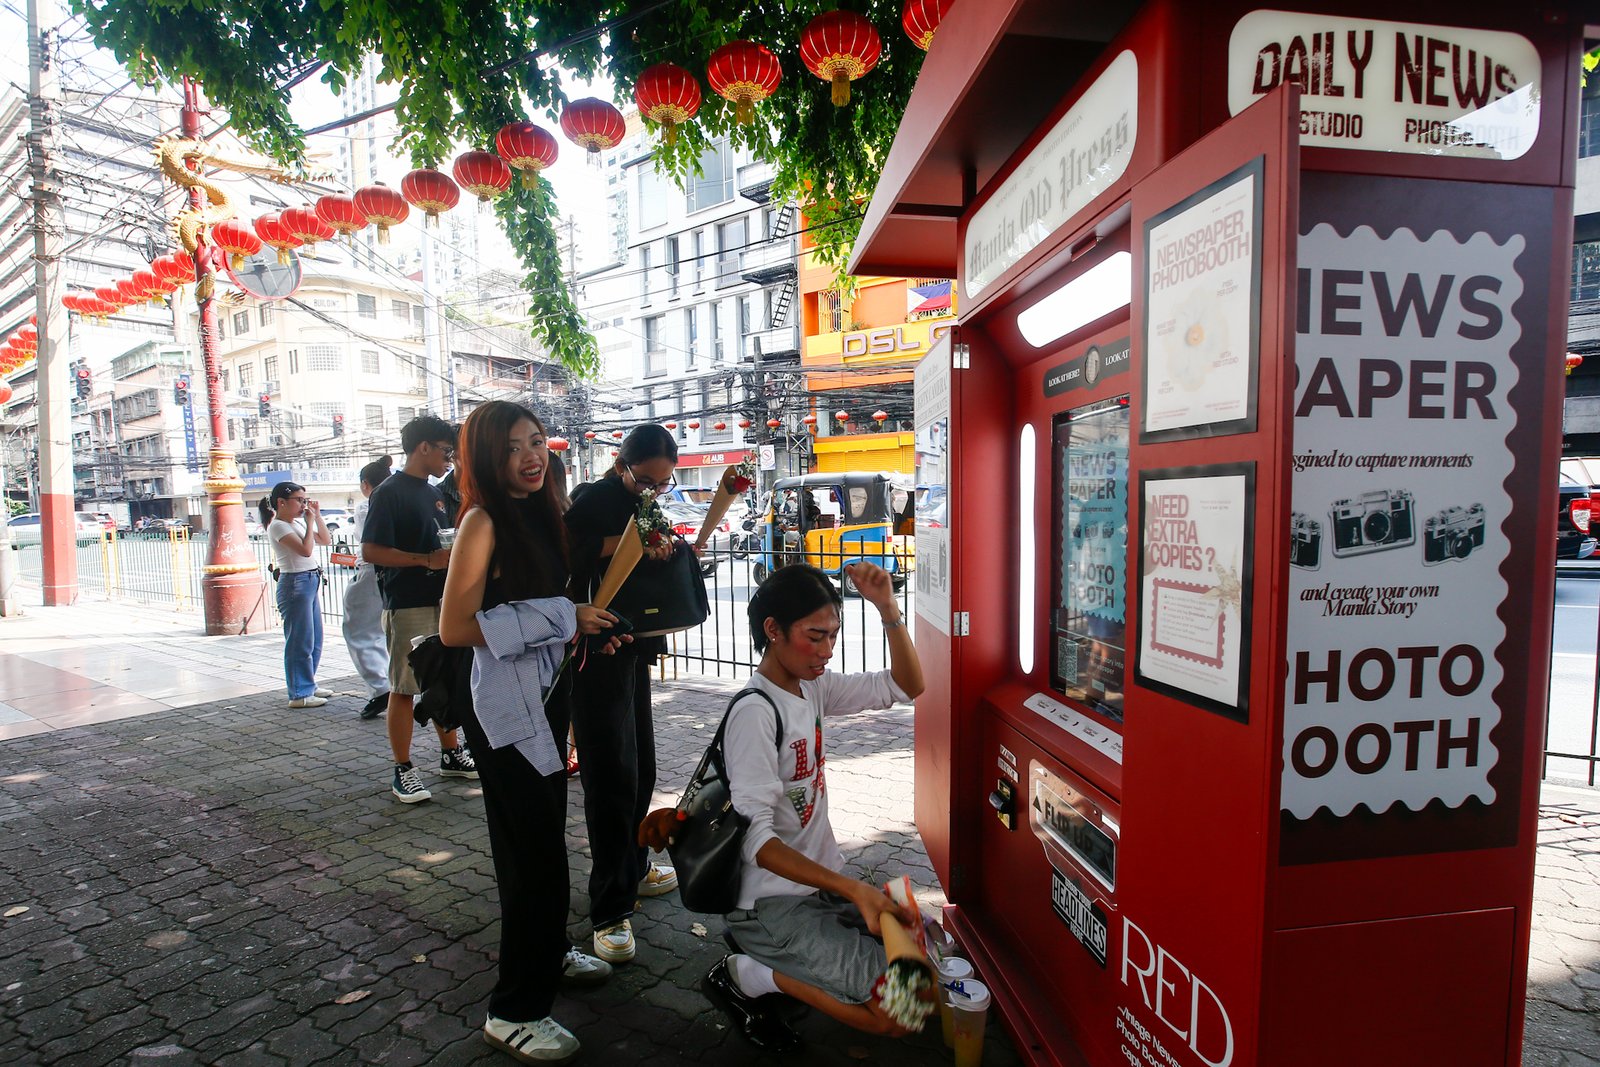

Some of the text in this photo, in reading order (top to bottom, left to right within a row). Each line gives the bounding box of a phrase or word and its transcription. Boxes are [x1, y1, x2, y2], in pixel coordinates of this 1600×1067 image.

[1252, 30, 1518, 114] DAILY NEWS
[1299, 110, 1363, 139] STUDIO
[1019, 176, 1052, 233] Old
[1059, 109, 1129, 213] Press
[1156, 209, 1245, 270] NEWSPAPER
[1151, 231, 1250, 294] PHOTOBOOTH
[843, 328, 921, 358] DSL
[1105, 352, 1121, 366] LOOK
[1294, 357, 1498, 420] APER
[711, 454, 724, 464] AUB
[1070, 451, 1117, 477] NEWS
[1338, 453, 1353, 468] to
[1355, 453, 1408, 473] capture
[1409, 452, 1474, 468] moments
[1070, 477, 1116, 501] PAPER
[1151, 494, 1190, 519] NEED
[1150, 519, 1199, 545] EXTRA
[1300, 582, 1440, 602] and create your own
[1322, 598, 1418, 619] Manila Story
[1285, 643, 1485, 705] HOTO
[1281, 717, 1481, 779] OOTH
[1045, 799, 1094, 853] FLIP UP
[1053, 875, 1106, 952] HEADLINES
[1120, 915, 1234, 1067] RED
[1116, 1016, 1140, 1049] Photo
[1116, 1005, 1182, 1067] Vintage News
